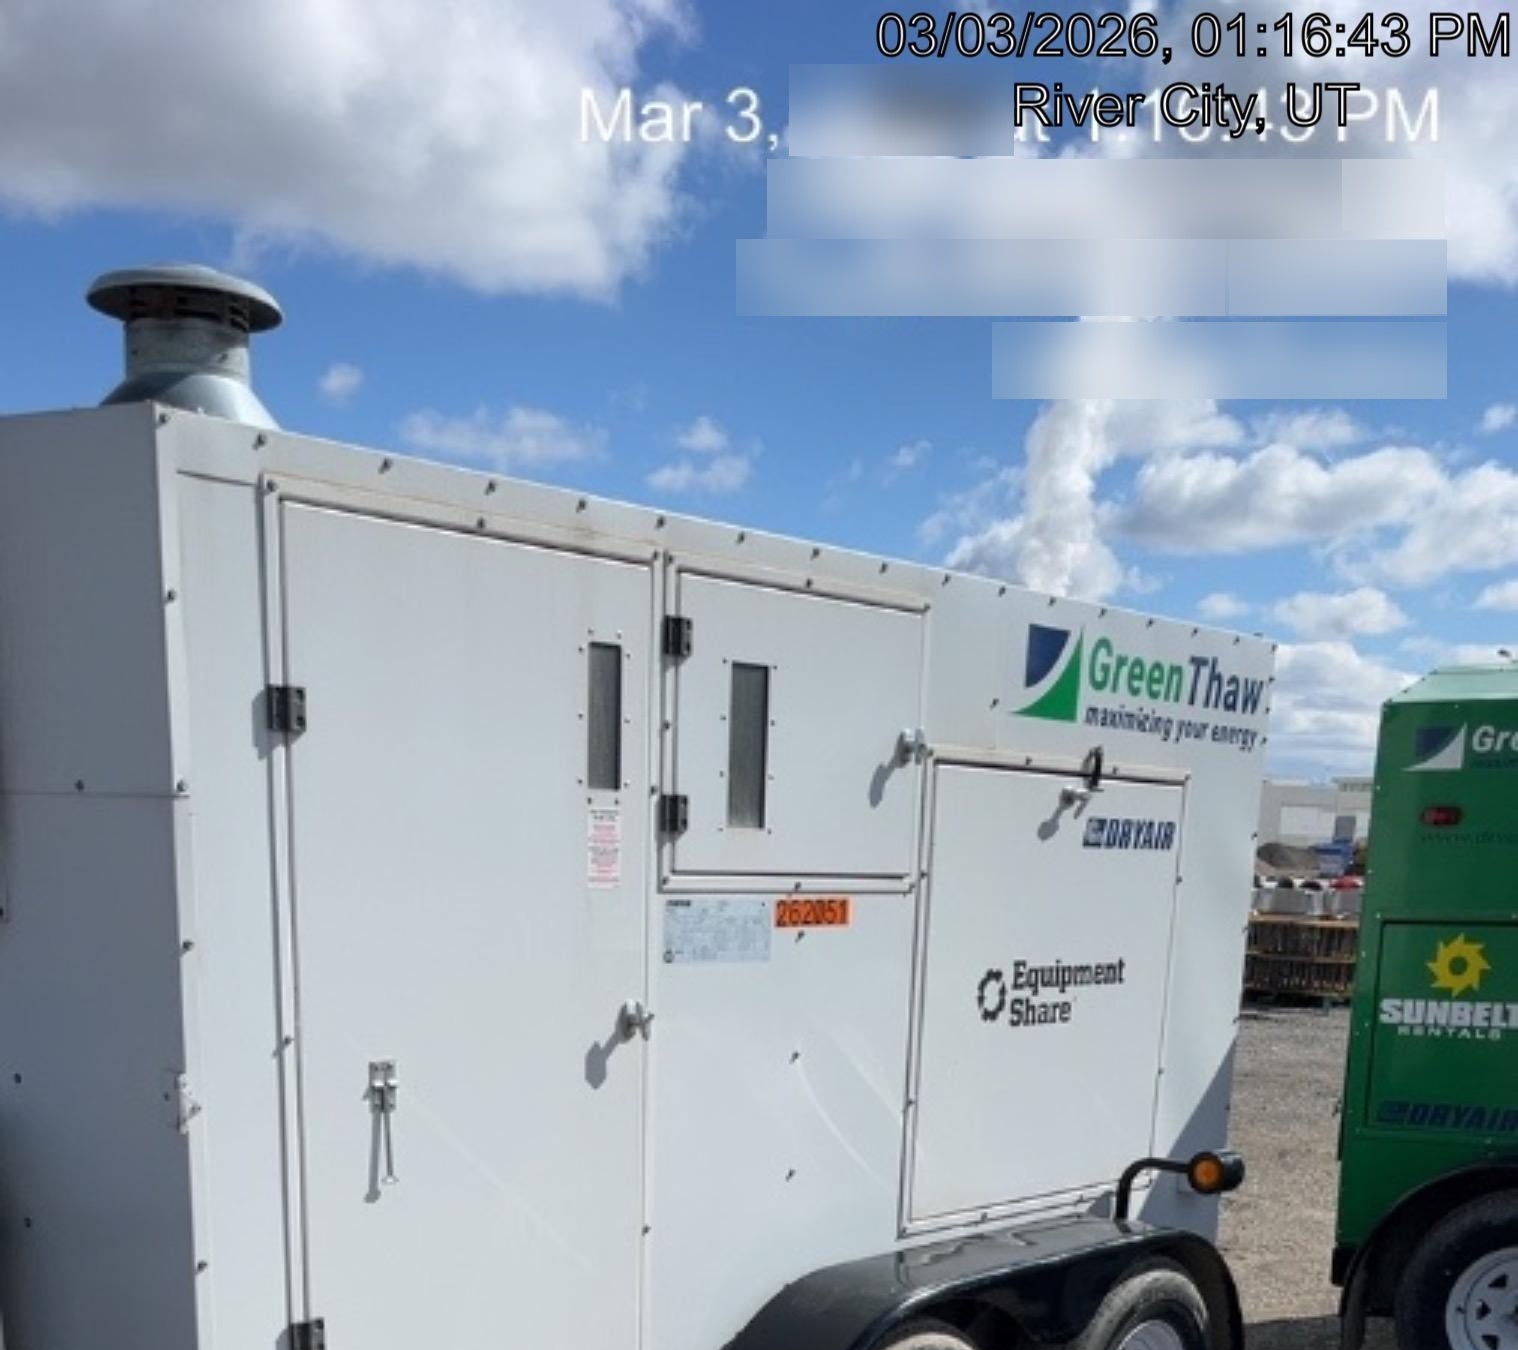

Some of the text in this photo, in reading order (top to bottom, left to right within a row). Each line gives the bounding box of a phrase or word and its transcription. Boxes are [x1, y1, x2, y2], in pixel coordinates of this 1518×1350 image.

[1085, 703, 1258, 752] maximizing your energy
[776, 900, 849, 927] 262051
[1011, 957, 1126, 996] Equipment
[1010, 998, 1072, 1026] Share
[1398, 1025, 1501, 1041] RENTALS
